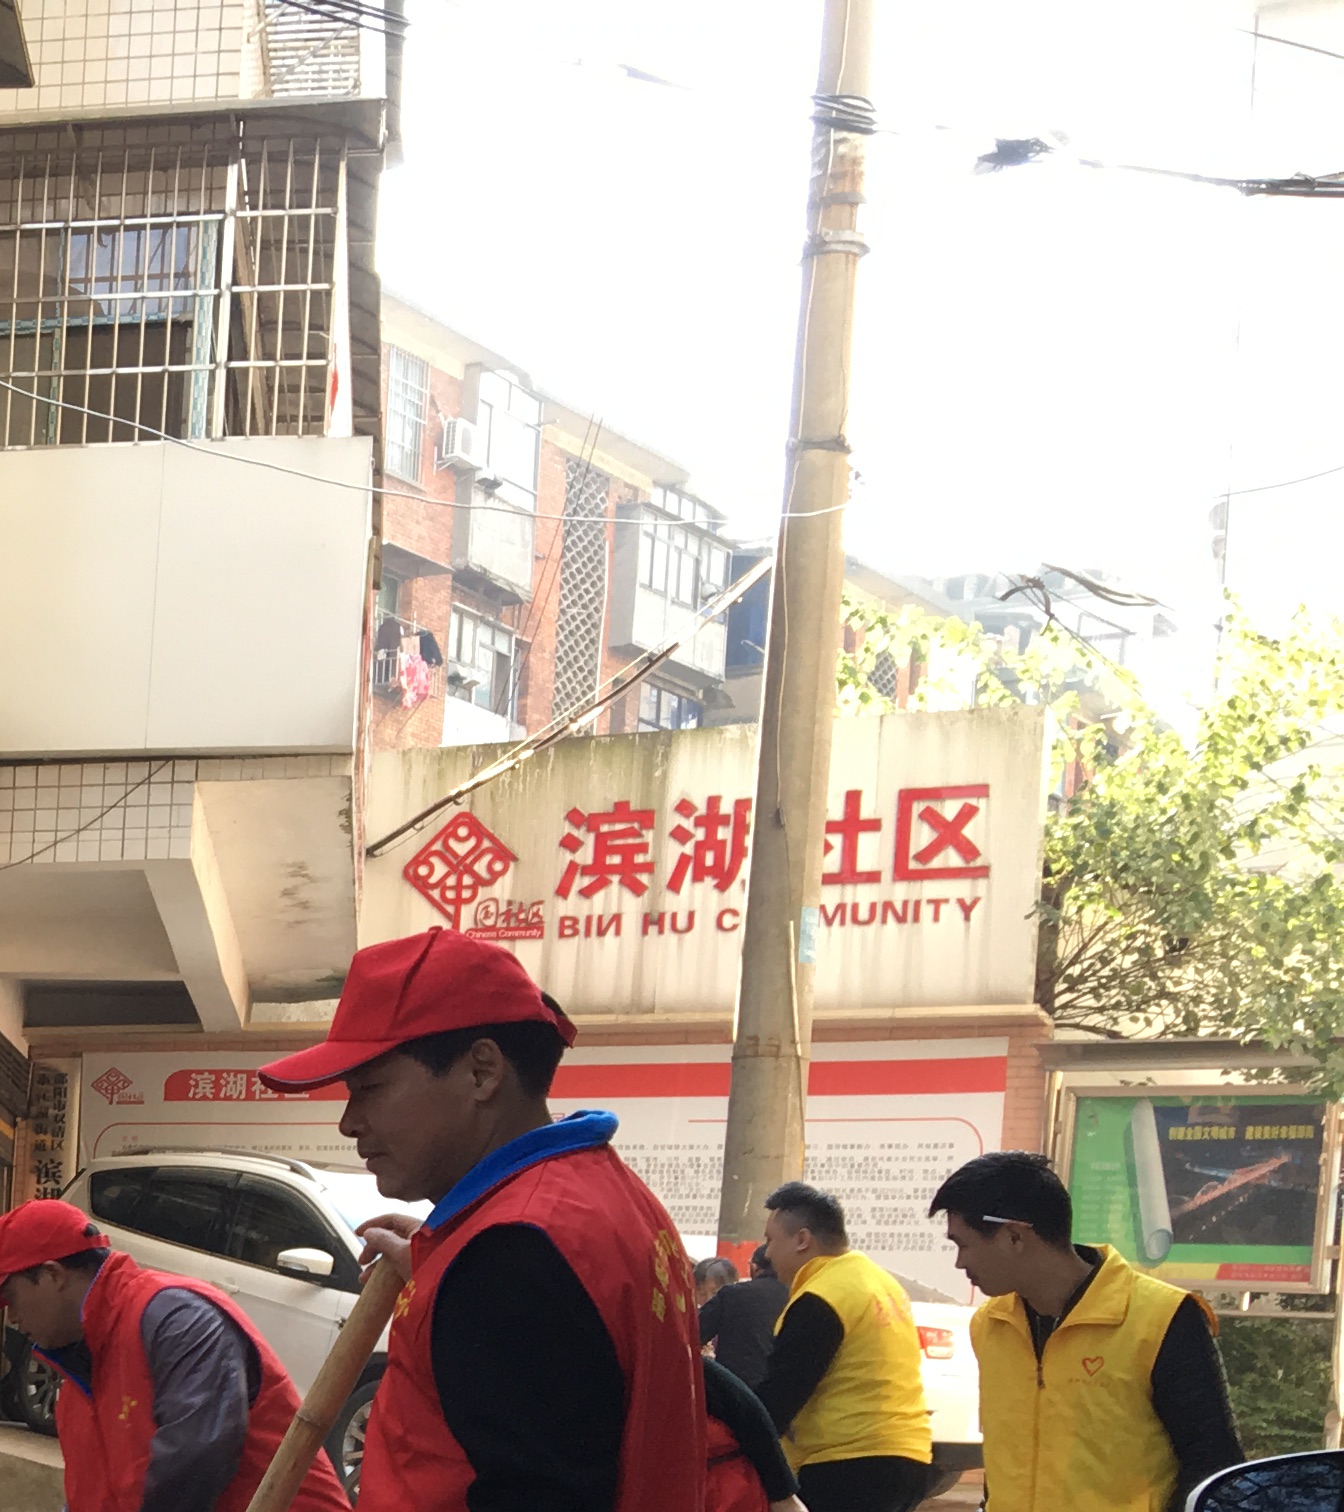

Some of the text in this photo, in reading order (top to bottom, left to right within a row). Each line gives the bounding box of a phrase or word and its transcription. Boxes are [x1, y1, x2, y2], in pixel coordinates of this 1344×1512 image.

[642, 910, 696, 936] HU
[716, 896, 981, 932] CMUNITY
[187, 1071, 311, 1100] 滨湖社
